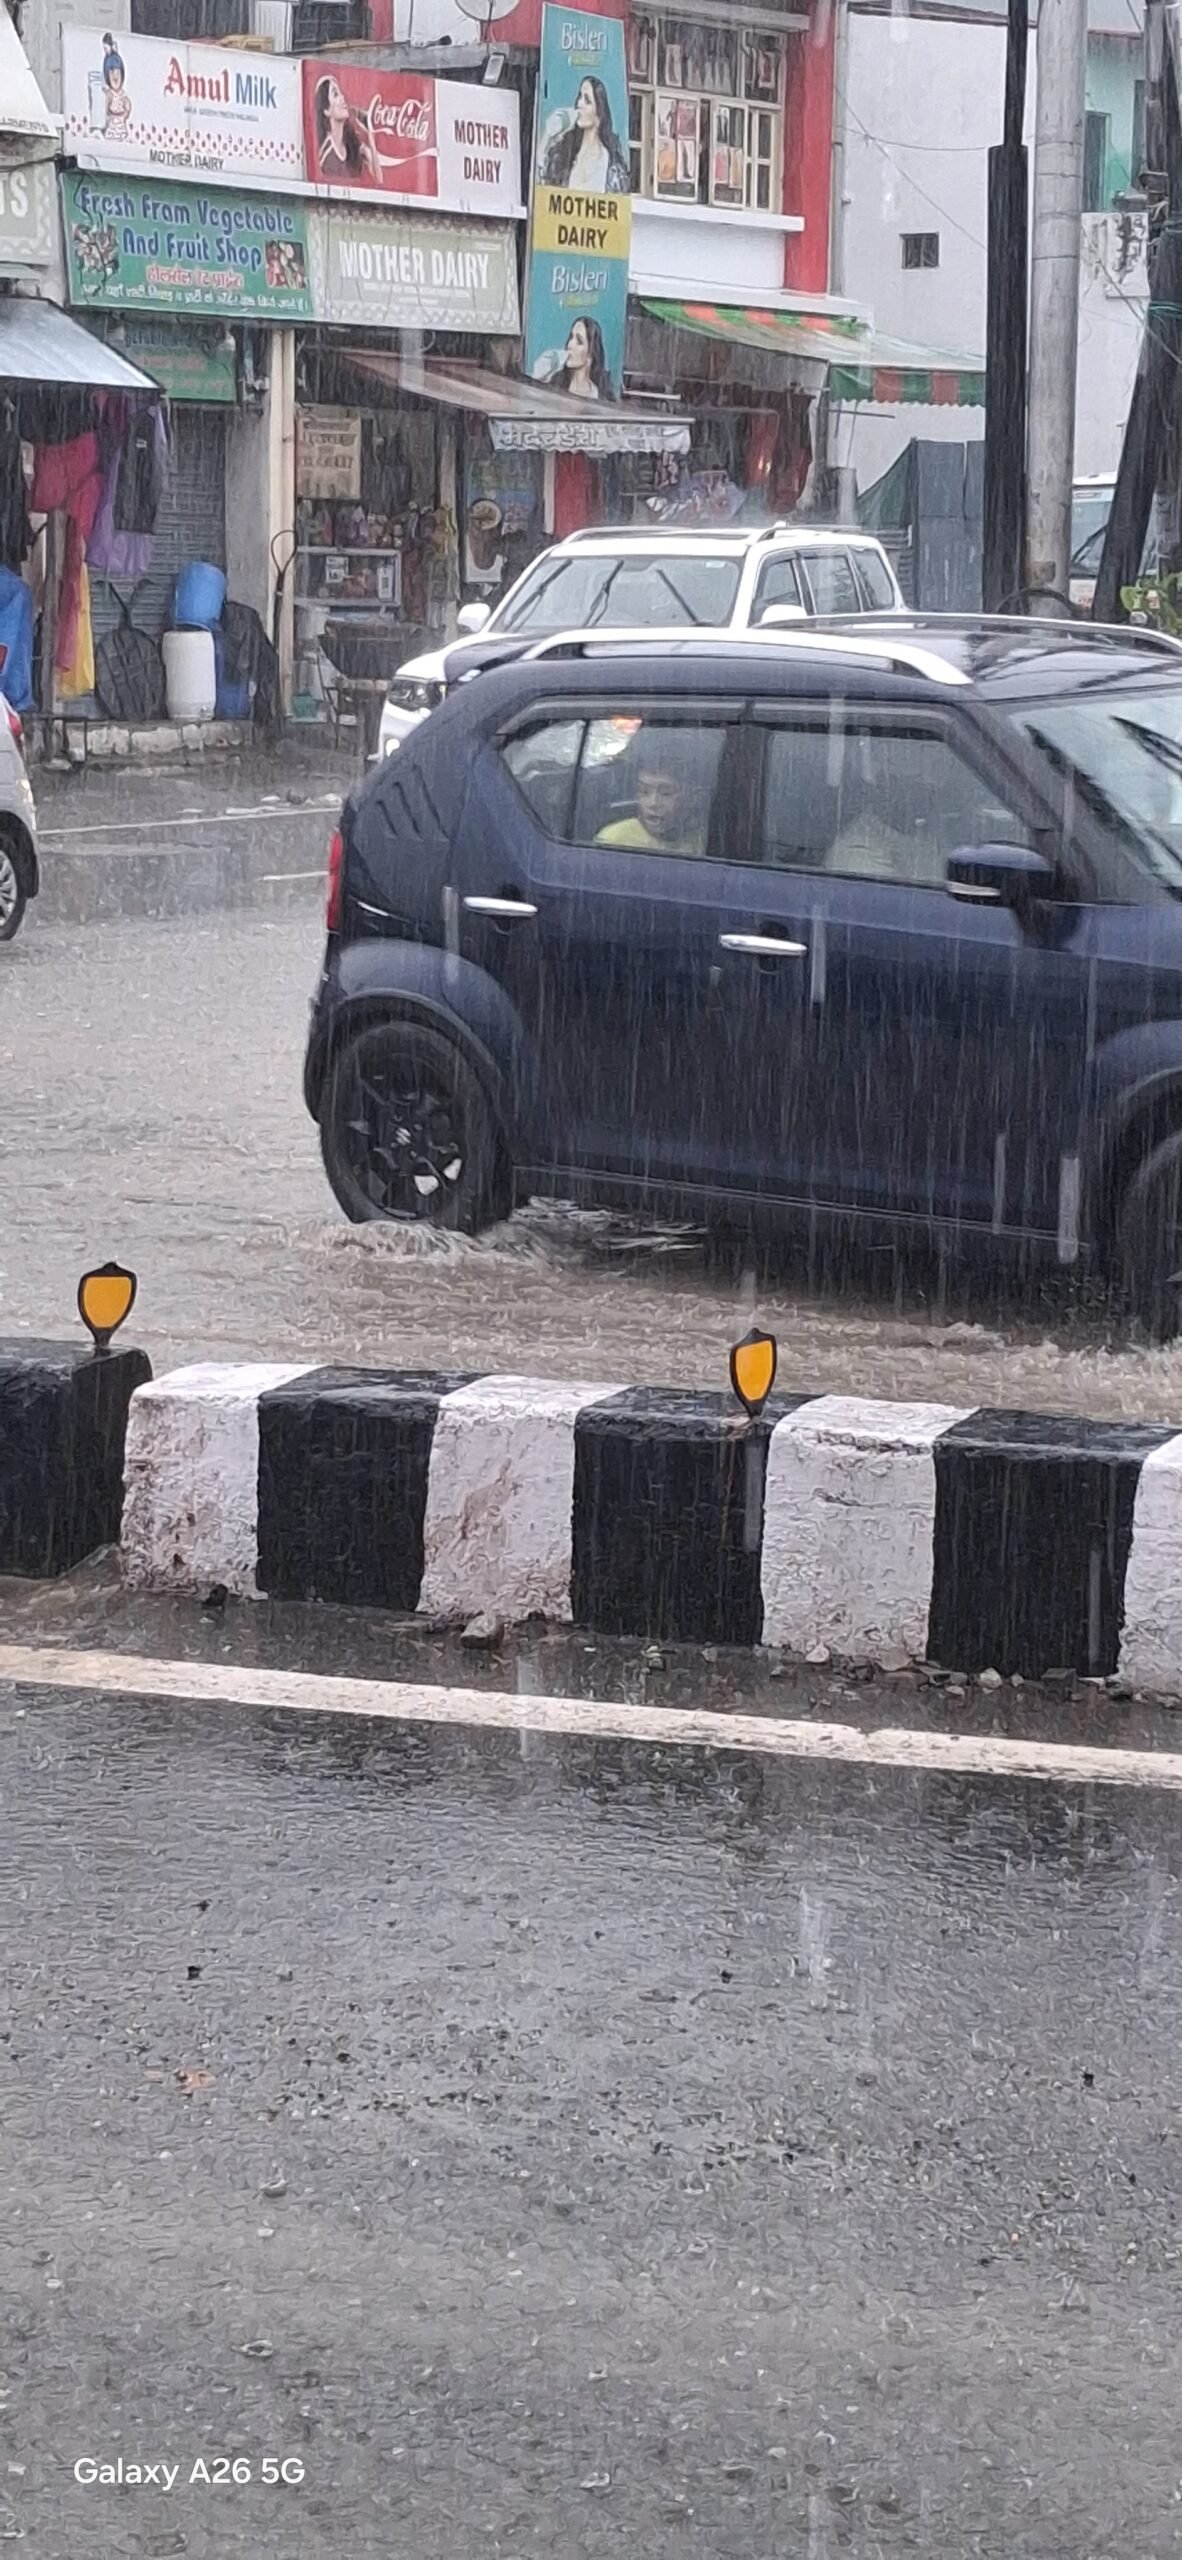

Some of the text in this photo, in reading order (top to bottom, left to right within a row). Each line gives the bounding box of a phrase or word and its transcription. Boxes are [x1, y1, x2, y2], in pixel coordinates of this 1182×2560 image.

[163, 56, 277, 109] Amul Milk
[454, 119, 508, 149] MOTHER
[149, 149, 224, 170] MOTHER DAIRY
[463, 157, 501, 184] DAIRY
[196, 199, 294, 236] Vegetable
[548, 194, 619, 222] MOTHER
[122, 227, 262, 272] And Fruit Shop
[557, 224, 608, 249] DAIRY
[339, 239, 489, 289] MOTHER DAIRY
[551, 261, 608, 294] Bisleri
